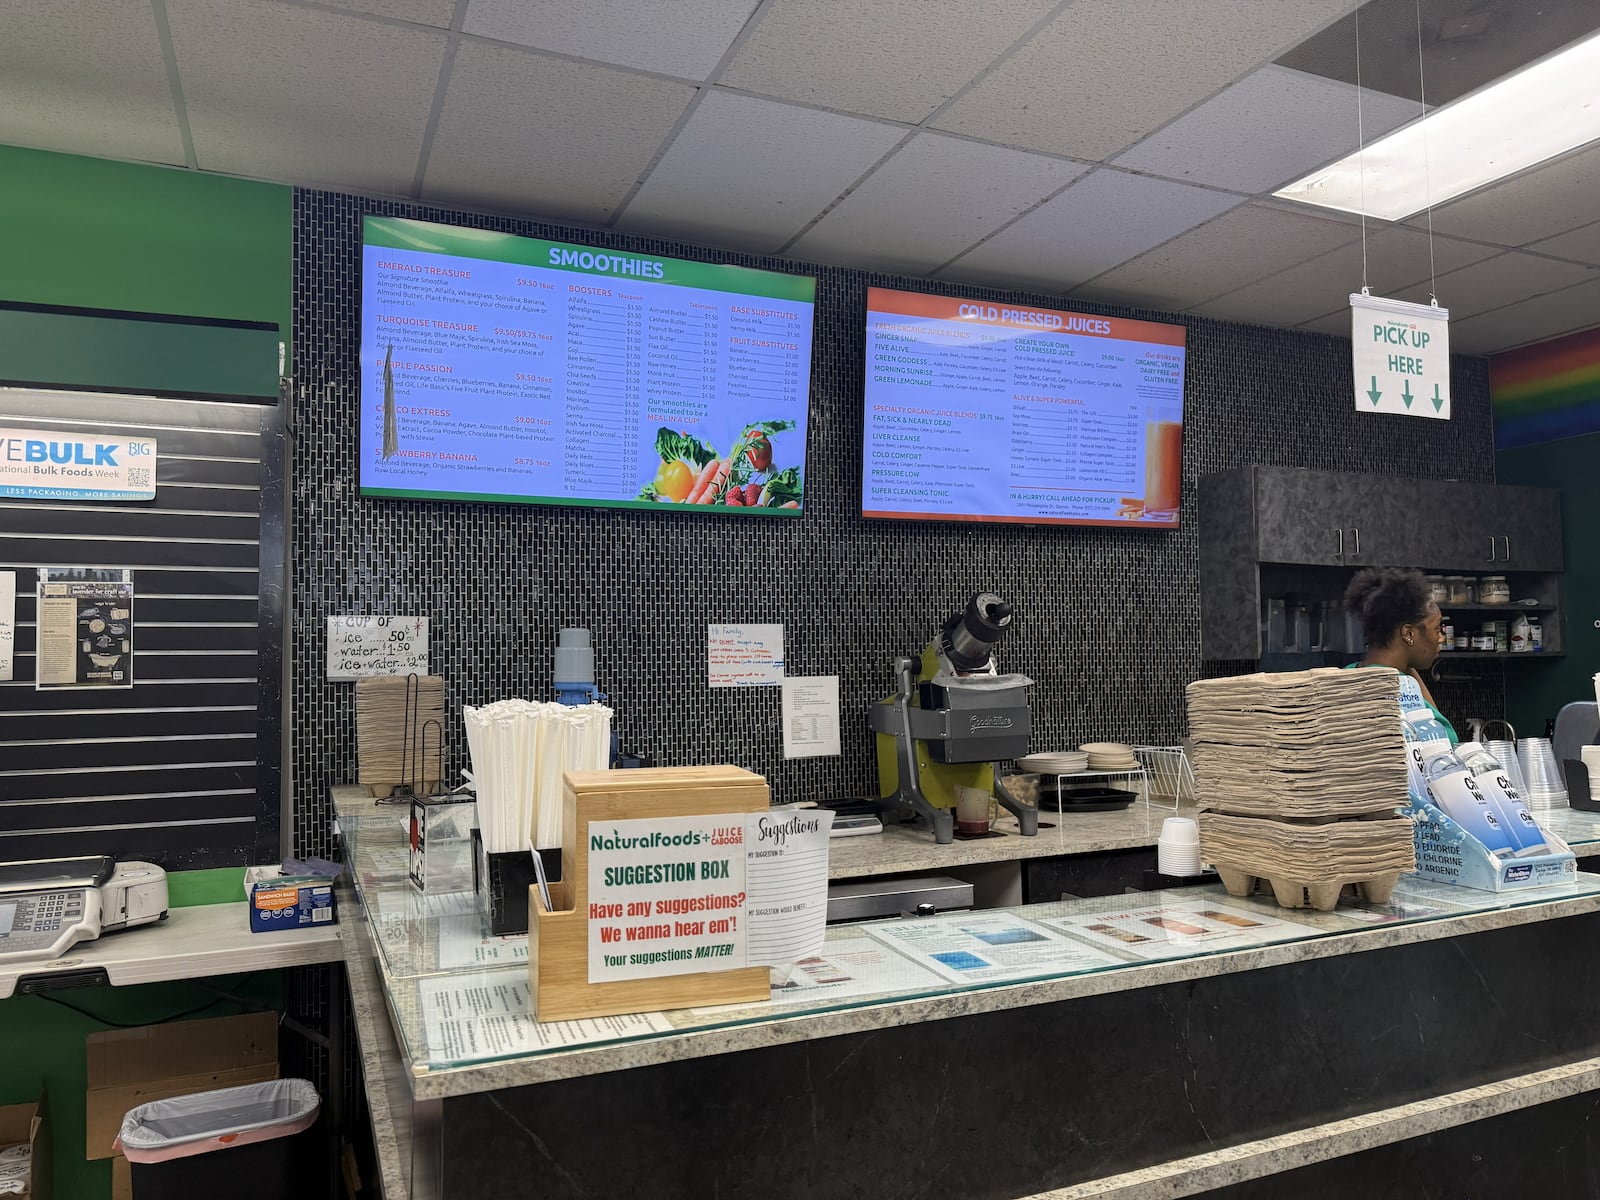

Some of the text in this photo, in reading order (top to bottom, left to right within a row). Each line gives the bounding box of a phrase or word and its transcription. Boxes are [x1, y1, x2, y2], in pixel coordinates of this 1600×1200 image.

[548, 246, 664, 279] SMOOTHIES
[378, 260, 471, 279] EMERALD TREASURE
[389, 273, 419, 283] Signature
[420, 277, 448, 286] Smoothie
[517, 278, 537, 288] $9.50
[377, 280, 401, 288] Almond
[402, 283, 434, 293] Beverage,
[568, 285, 611, 297] BOOSTERS
[731, 306, 797, 320] BASE SUBSTITUTES
[959, 303, 1110, 335] COLD PRESSED JUICES
[377, 314, 478, 333] TURQUOISE TREASURE
[494, 327, 536, 339] $9.50/$9.75
[875, 332, 899, 341] GINGER
[1374, 325, 1430, 348] PICK UP
[730, 337, 797, 351] FRUIT SUBSTITUTES
[897, 356, 927, 364] GODDESS
[1388, 354, 1423, 375] HERE
[376, 359, 452, 374] PRPLE PASSION
[874, 365, 905, 373] MORNING
[515, 374, 535, 382] $9.50
[897, 378, 932, 386] LEMONADE
[661, 399, 696, 408] smoothies
[873, 405, 906, 413] SPECIALTY
[411, 407, 450, 417] EXTRESS
[648, 406, 684, 414] formulated
[128, 442, 150, 457] BIG
[439, 452, 477, 461] BANANA
[0, 465, 120, 478] ational Bulk Foods Week
[28, 488, 82, 497] PACKAGING.
[345, 616, 394, 628] CUP OF
[344, 632, 362, 643] ice
[711, 826, 743, 836] JUICE
[758, 816, 820, 846] Suggestions
[1421, 832, 1440, 841] LEAD
[711, 836, 743, 846] CABOOSE
[755, 850, 779, 859] SUGGESTION
[1422, 842, 1461, 855] FLUORIDE
[1424, 853, 1463, 867] CHLORINE
[604, 859, 729, 887] SUGGESTION BOX
[1425, 864, 1459, 877] ARSENIC
[589, 892, 746, 920] Have any suggestions?
[755, 906, 779, 916] SUGGESTION
[600, 926, 621, 944] We
[625, 923, 671, 941] wanna
[675, 920, 705, 938] hear
[604, 944, 734, 967] Your suggestions MATTER!
